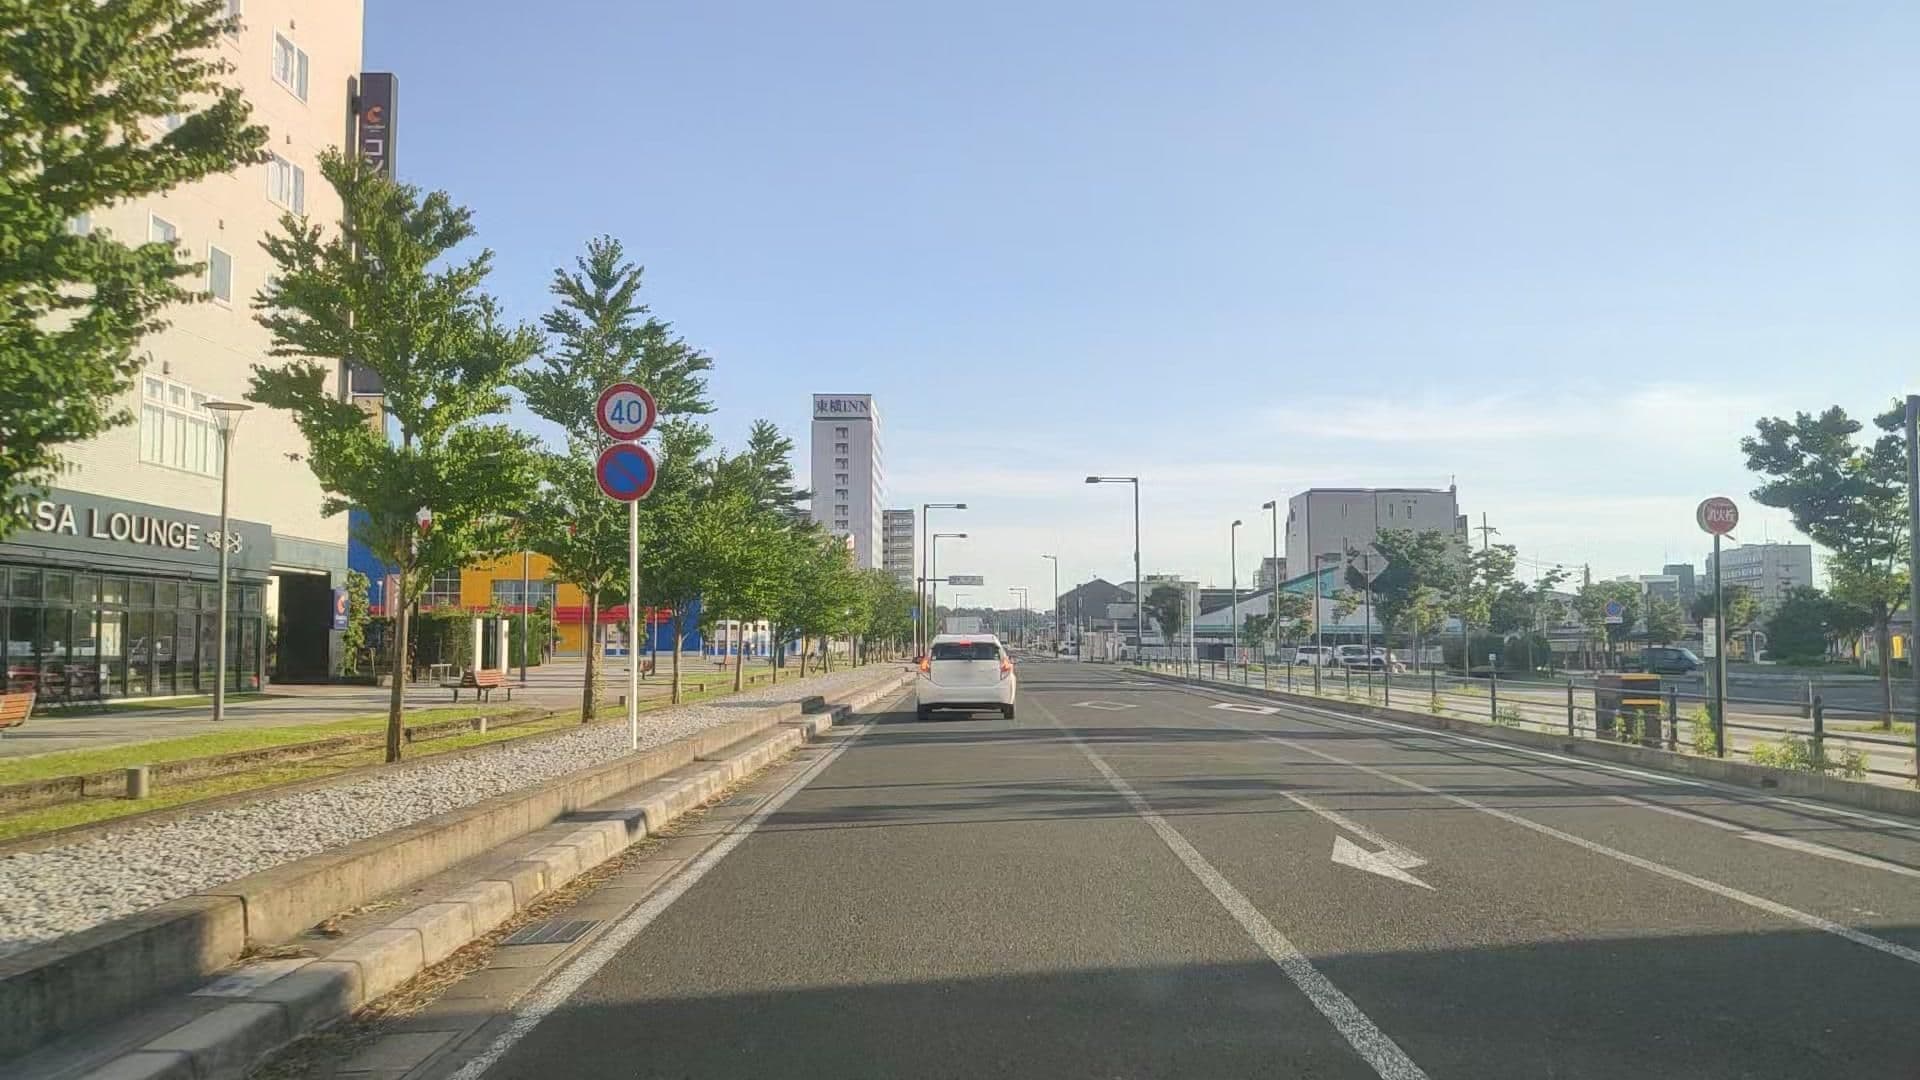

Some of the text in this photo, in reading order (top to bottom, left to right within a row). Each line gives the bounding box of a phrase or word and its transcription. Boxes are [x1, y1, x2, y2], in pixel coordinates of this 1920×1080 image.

[611, 399, 642, 425] 40
[816, 399, 869, 414] 東横INN
[91, 508, 200, 551] LOUNGE
